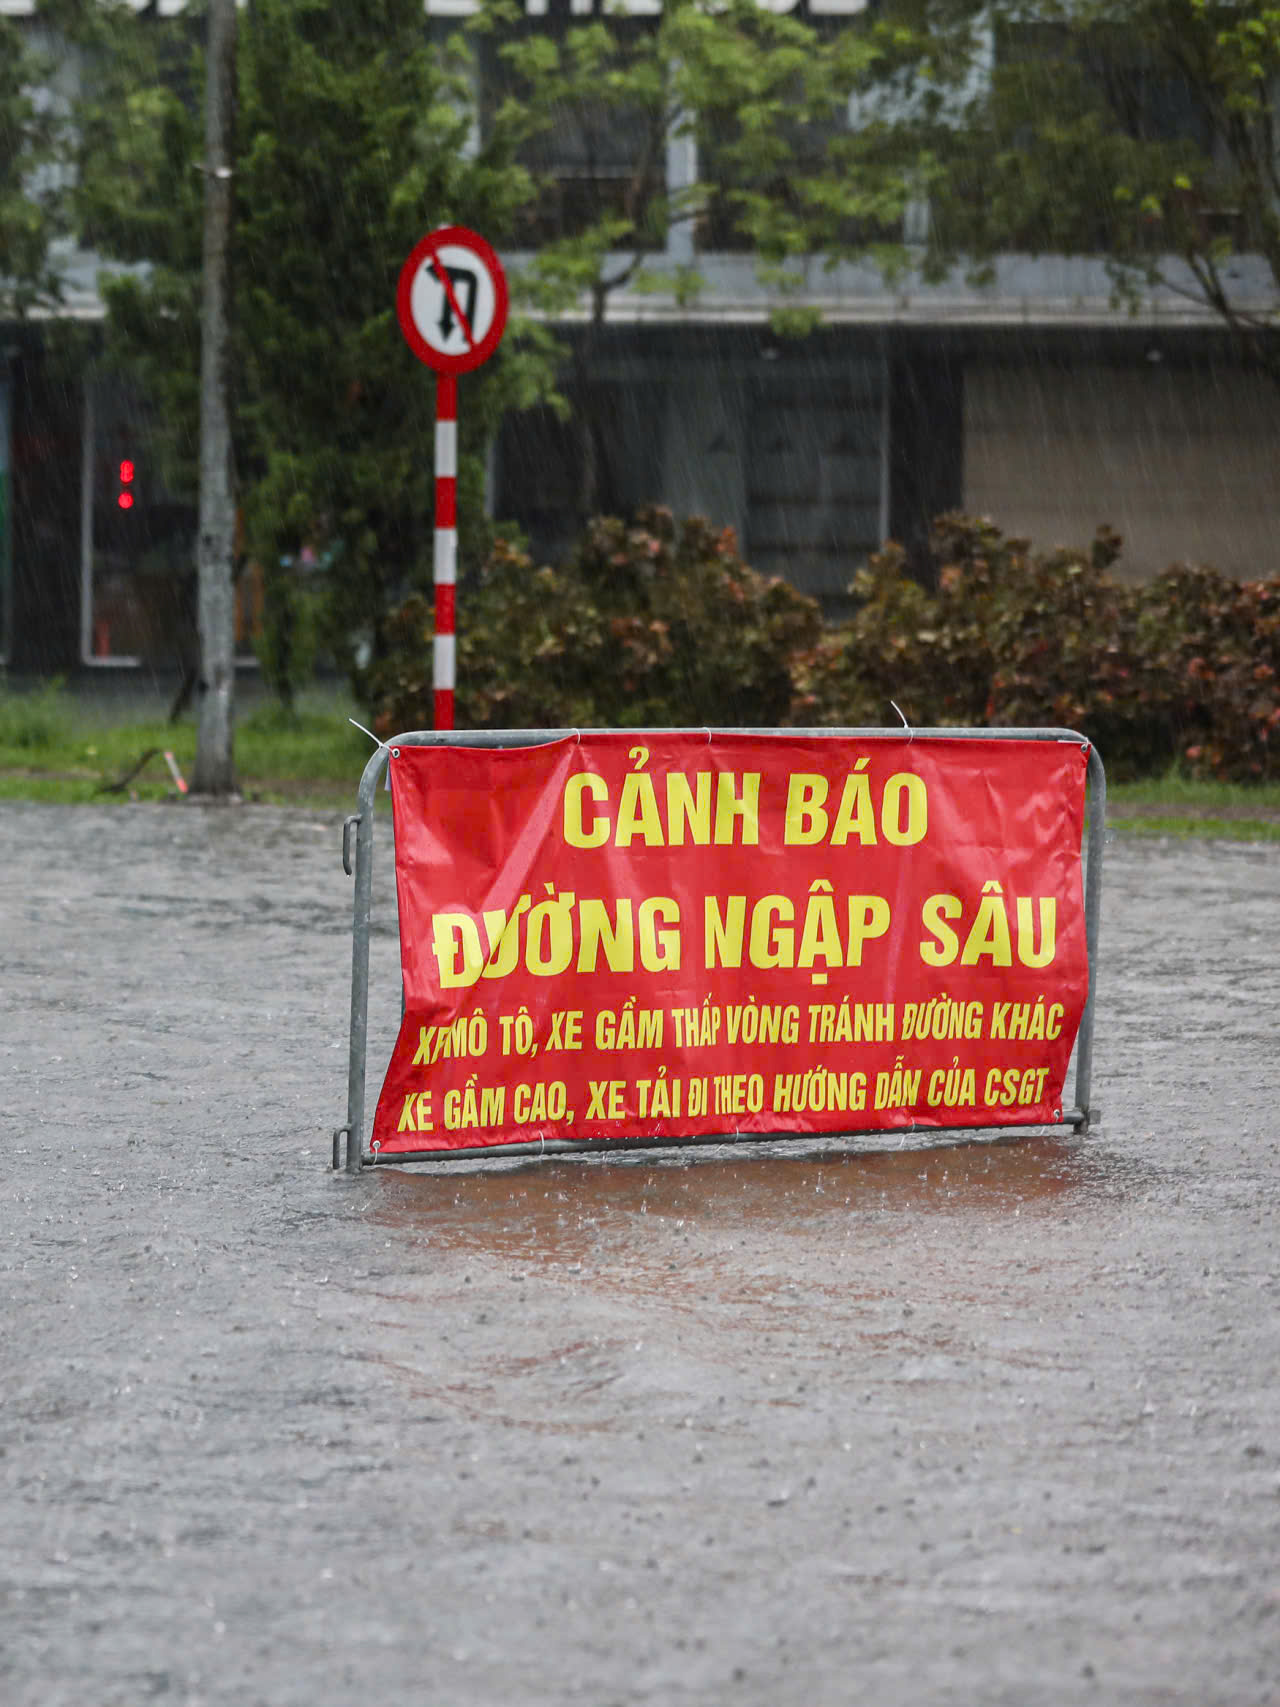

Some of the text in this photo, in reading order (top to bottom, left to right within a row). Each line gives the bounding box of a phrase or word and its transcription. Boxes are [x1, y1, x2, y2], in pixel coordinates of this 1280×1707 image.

[563, 746, 928, 849] CẢNH BÁO
[431, 879, 1058, 989] ĐƯỜNG NGẬP SÂU
[498, 1006, 539, 1058] TÔ,
[545, 1010, 584, 1051] XE
[594, 995, 664, 1050] GẦM
[671, 992, 721, 1048] THẤP
[726, 995, 800, 1044] VÒNG
[807, 995, 895, 1043] TRÁNH
[901, 992, 984, 1041] ĐƯỜNG
[990, 995, 1065, 1041] KHÁC
[397, 1055, 1050, 1132] XE GẦM CAO, XE TẢI ĐI THEO HƯỚNG DẪN CỦA CSGT
